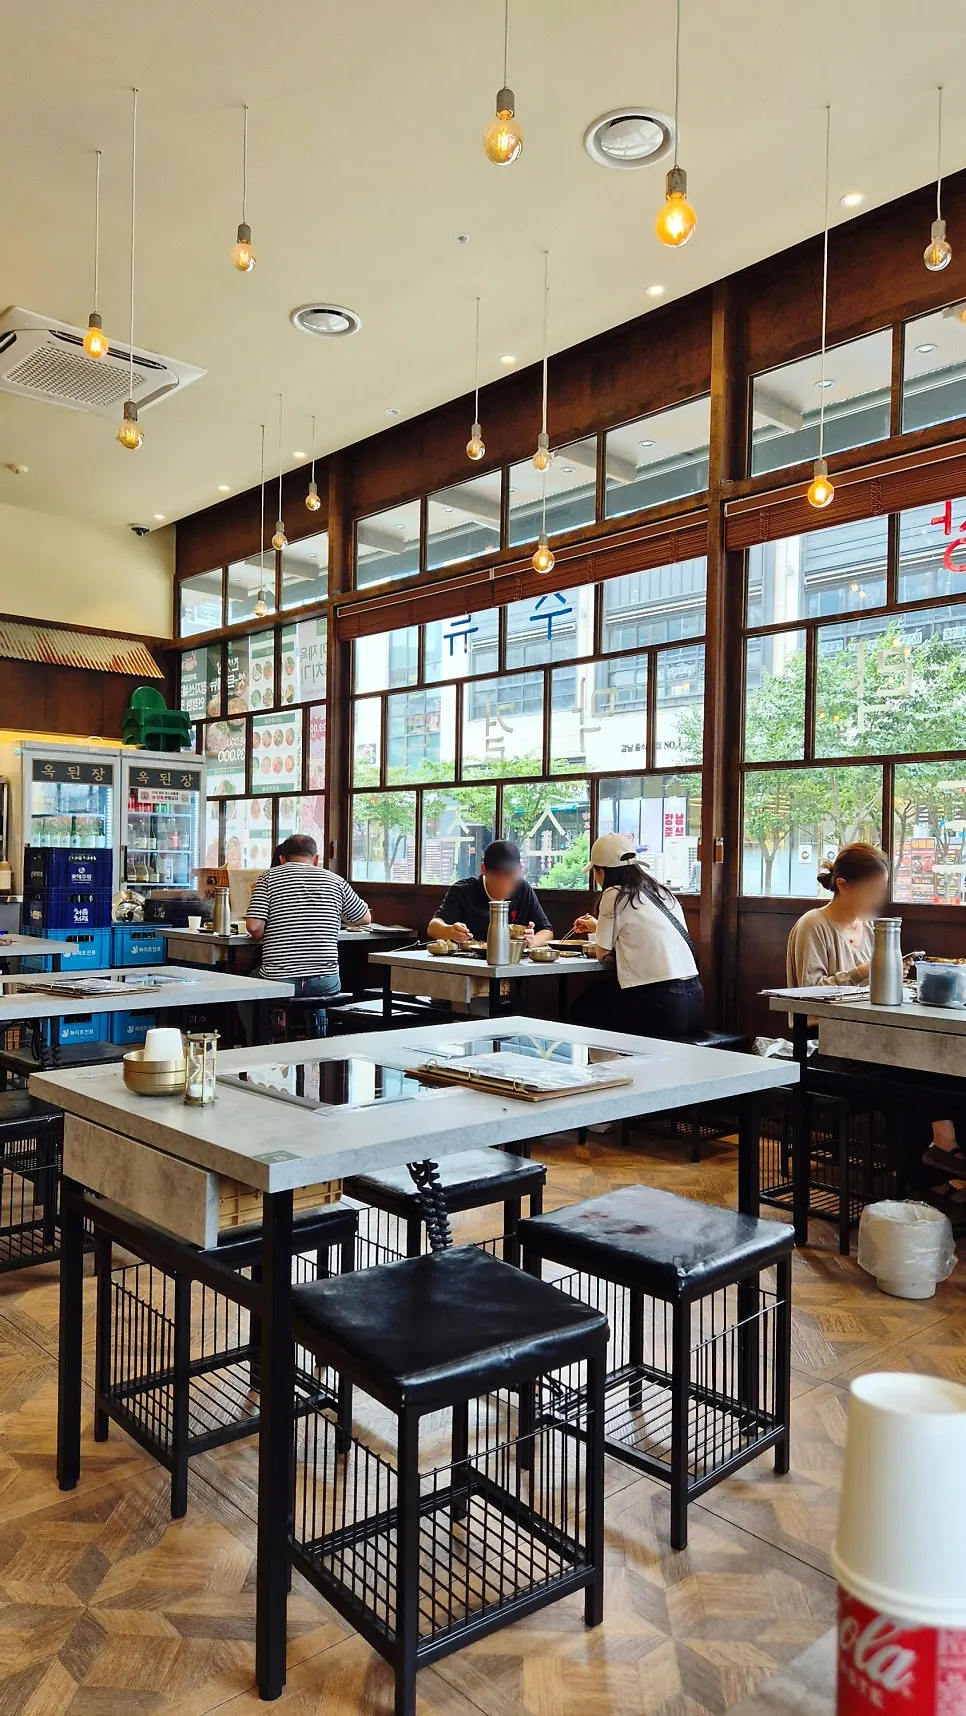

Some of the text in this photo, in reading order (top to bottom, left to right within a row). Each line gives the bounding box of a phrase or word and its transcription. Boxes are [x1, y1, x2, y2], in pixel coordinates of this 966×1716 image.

[41, 764, 106, 782] 옥된장
[136, 771, 194, 788] 옥된장
[665, 813, 684, 825] 강남
